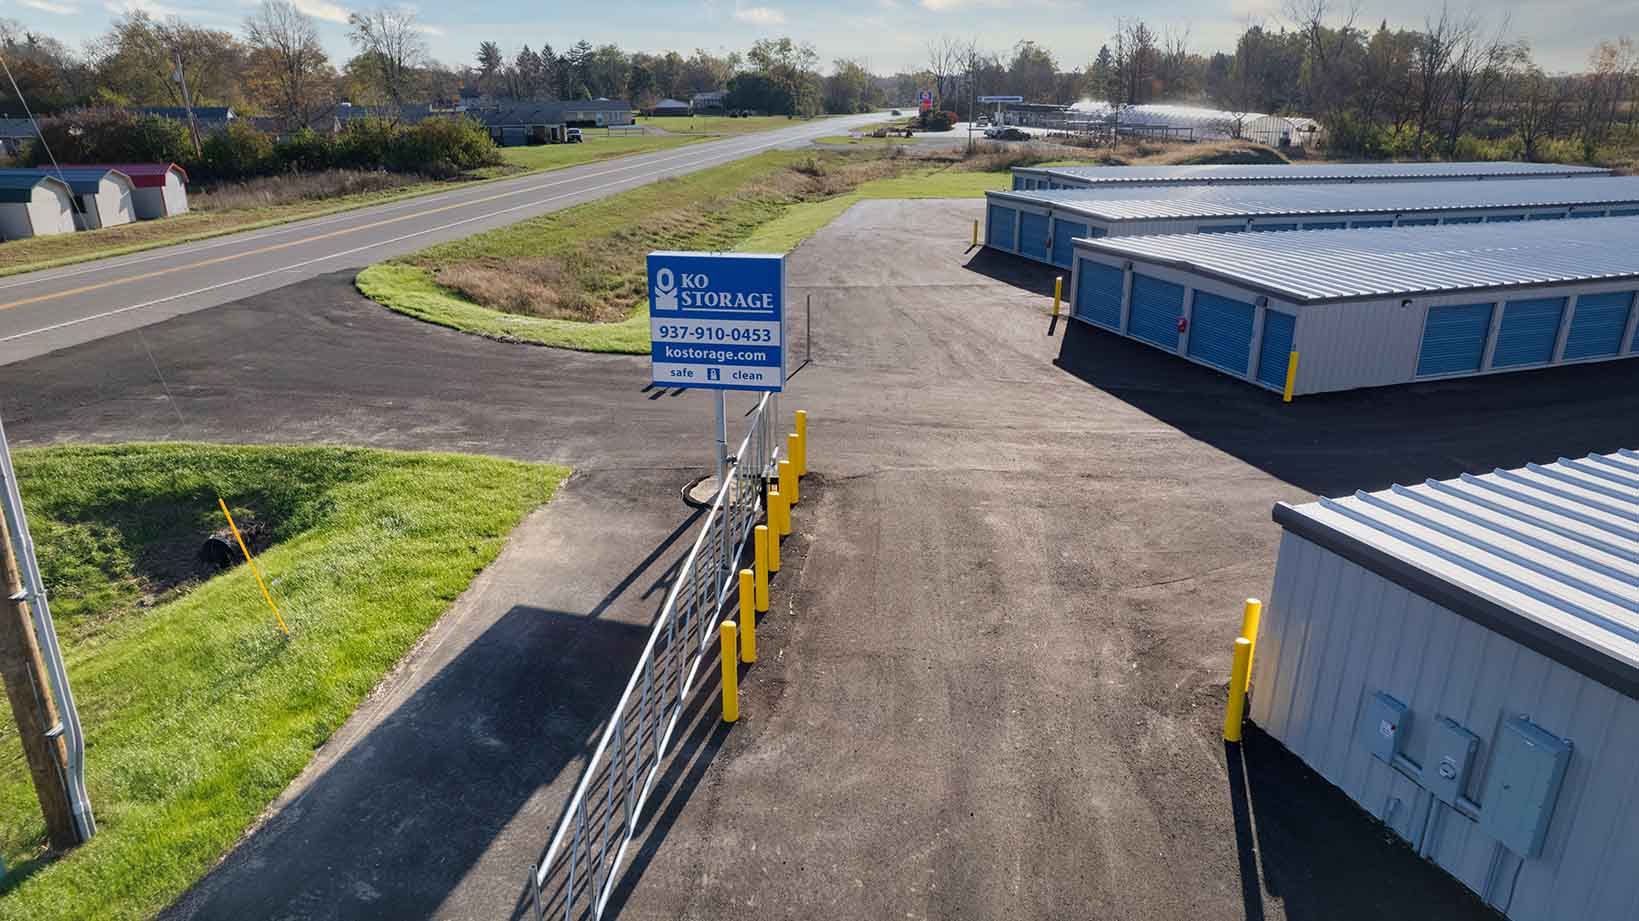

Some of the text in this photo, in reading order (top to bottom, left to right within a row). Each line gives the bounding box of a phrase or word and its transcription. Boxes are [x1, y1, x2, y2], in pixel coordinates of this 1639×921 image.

[681, 273, 709, 289] KO
[681, 291, 774, 309] STORAGE
[659, 325, 771, 342] 937-910-0453
[665, 345, 766, 362] kostorage.com
[670, 367, 763, 381] safe clean
